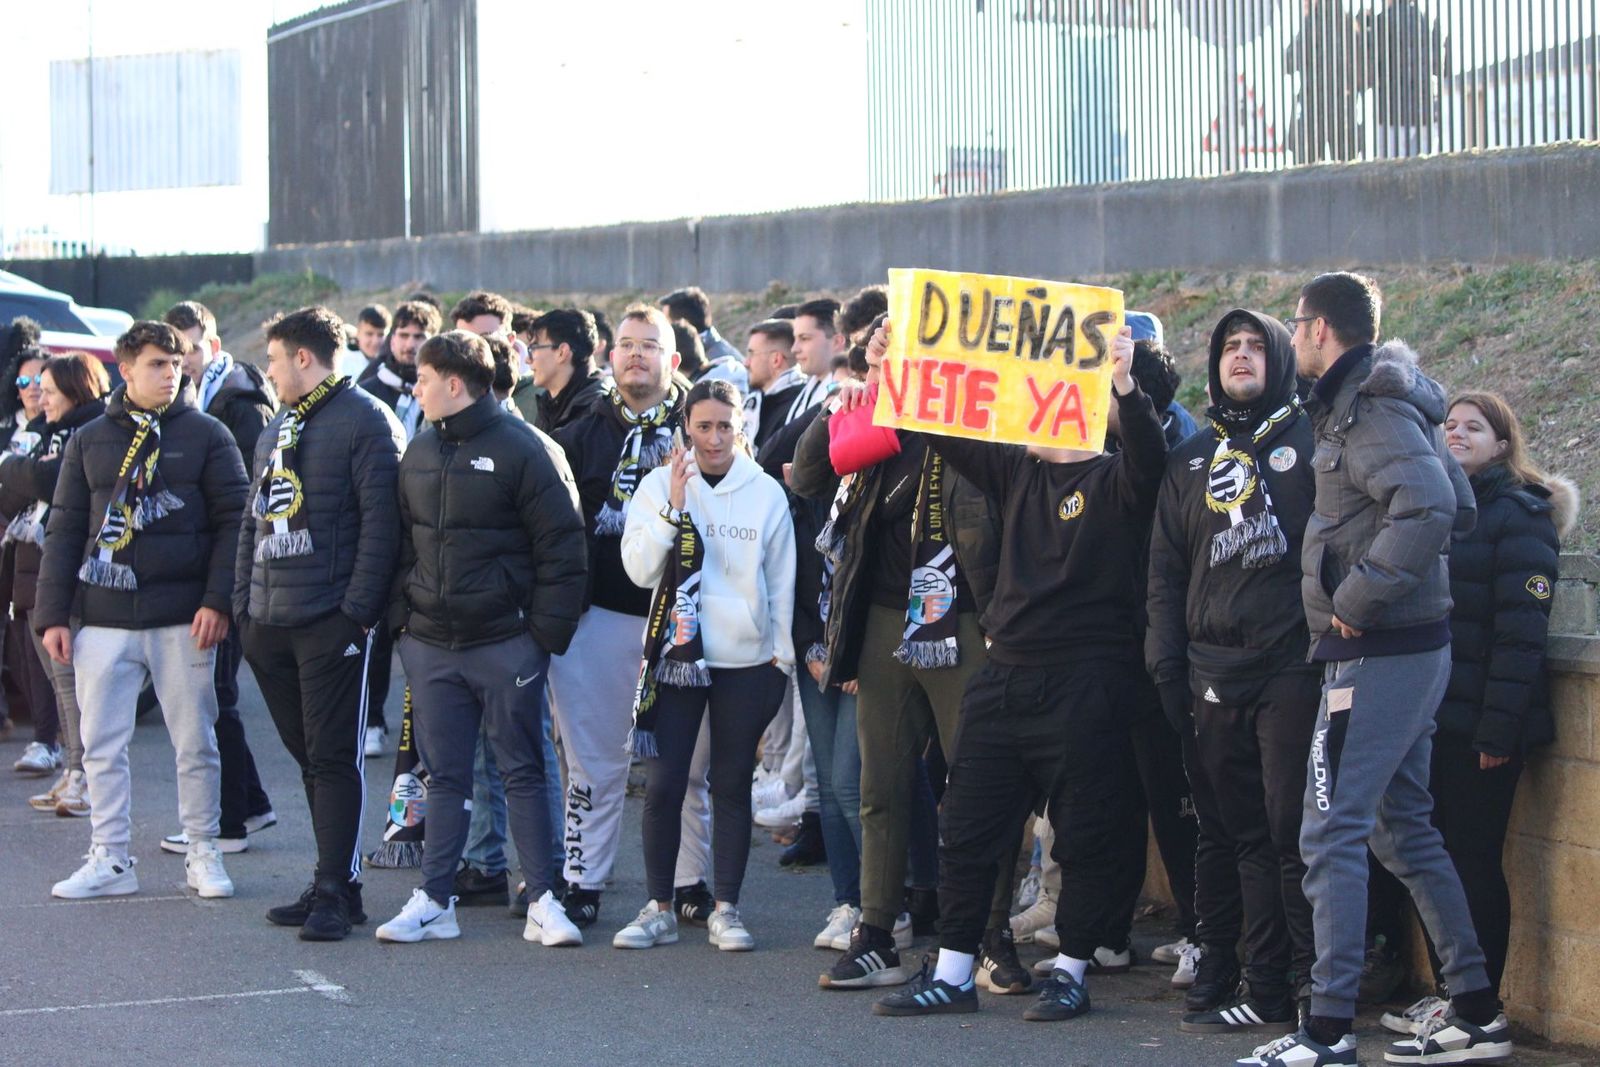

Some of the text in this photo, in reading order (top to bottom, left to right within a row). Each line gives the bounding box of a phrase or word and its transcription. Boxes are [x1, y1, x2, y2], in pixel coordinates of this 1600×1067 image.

[918, 280, 1117, 370] DUEÑAS
[882, 358, 1088, 441] VETE YA
[929, 453, 943, 541] A UNA LEYEN
[681, 532, 695, 556] UNA
[681, 559, 693, 568] A
[1312, 729, 1330, 811] WRLDWD
[566, 781, 593, 875] Beast
